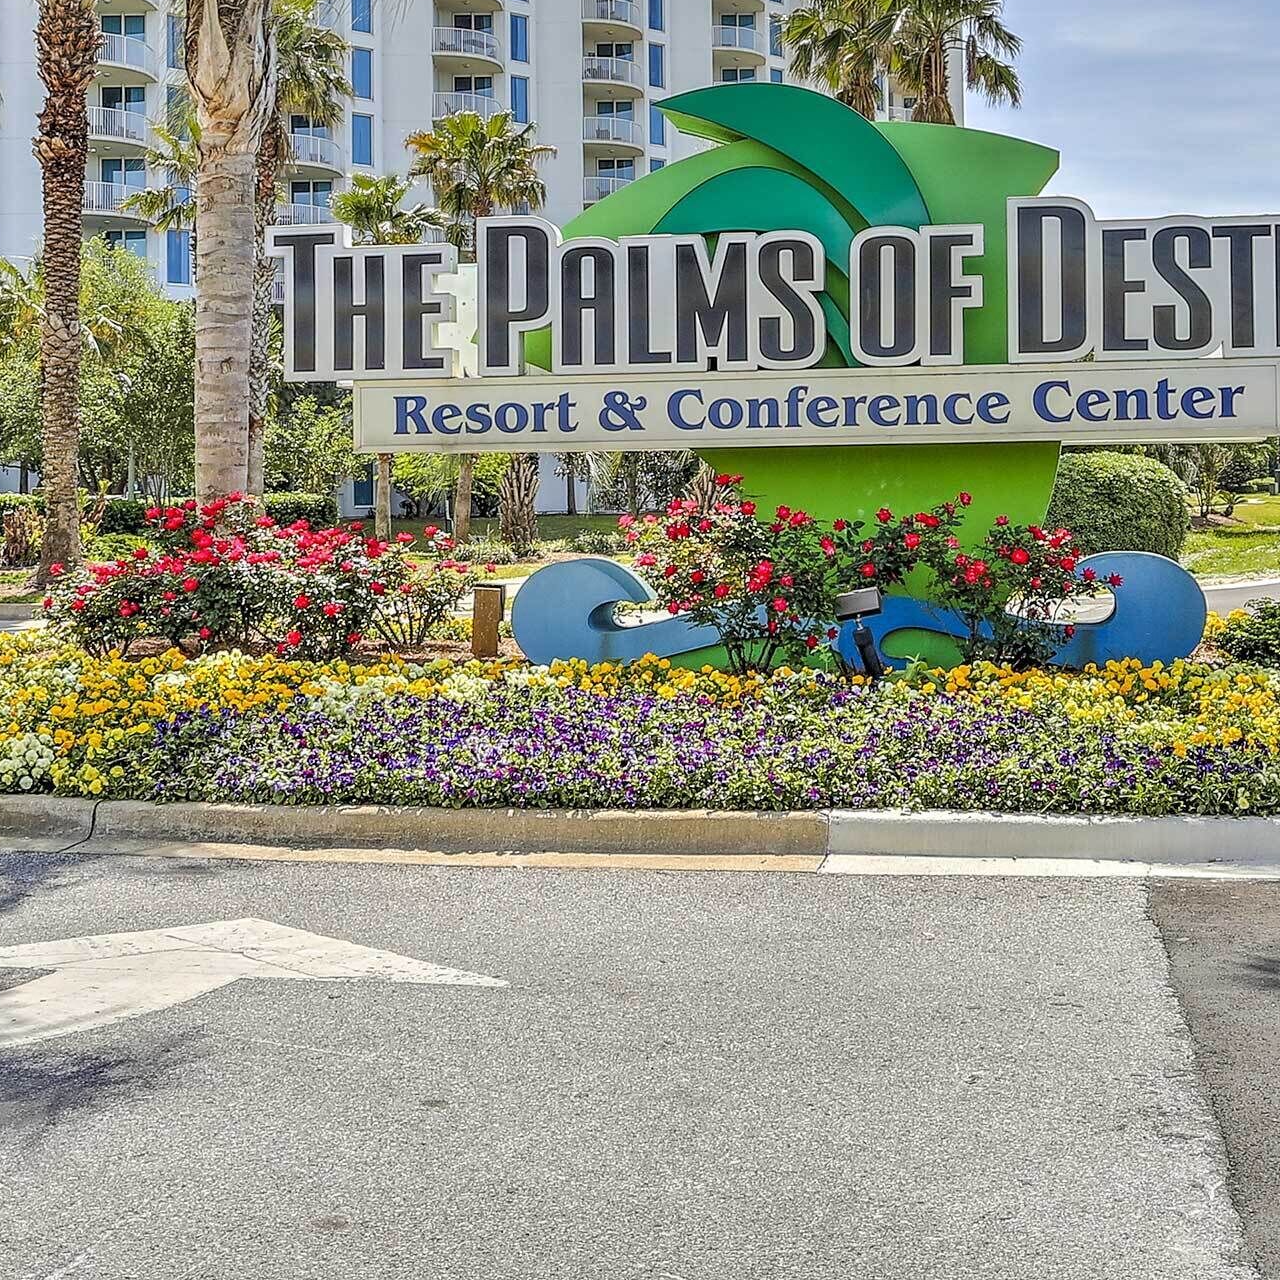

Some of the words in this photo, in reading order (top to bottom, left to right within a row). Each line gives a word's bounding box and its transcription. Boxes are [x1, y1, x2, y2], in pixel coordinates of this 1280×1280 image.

[273, 232, 445, 373] THE
[486, 225, 816, 368] PALMS
[859, 234, 974, 358] OF
[392, 391, 580, 435] Resort
[598, 390, 647, 432] &
[666, 385, 1012, 431] Conference
[1032, 377, 1247, 423] Center
